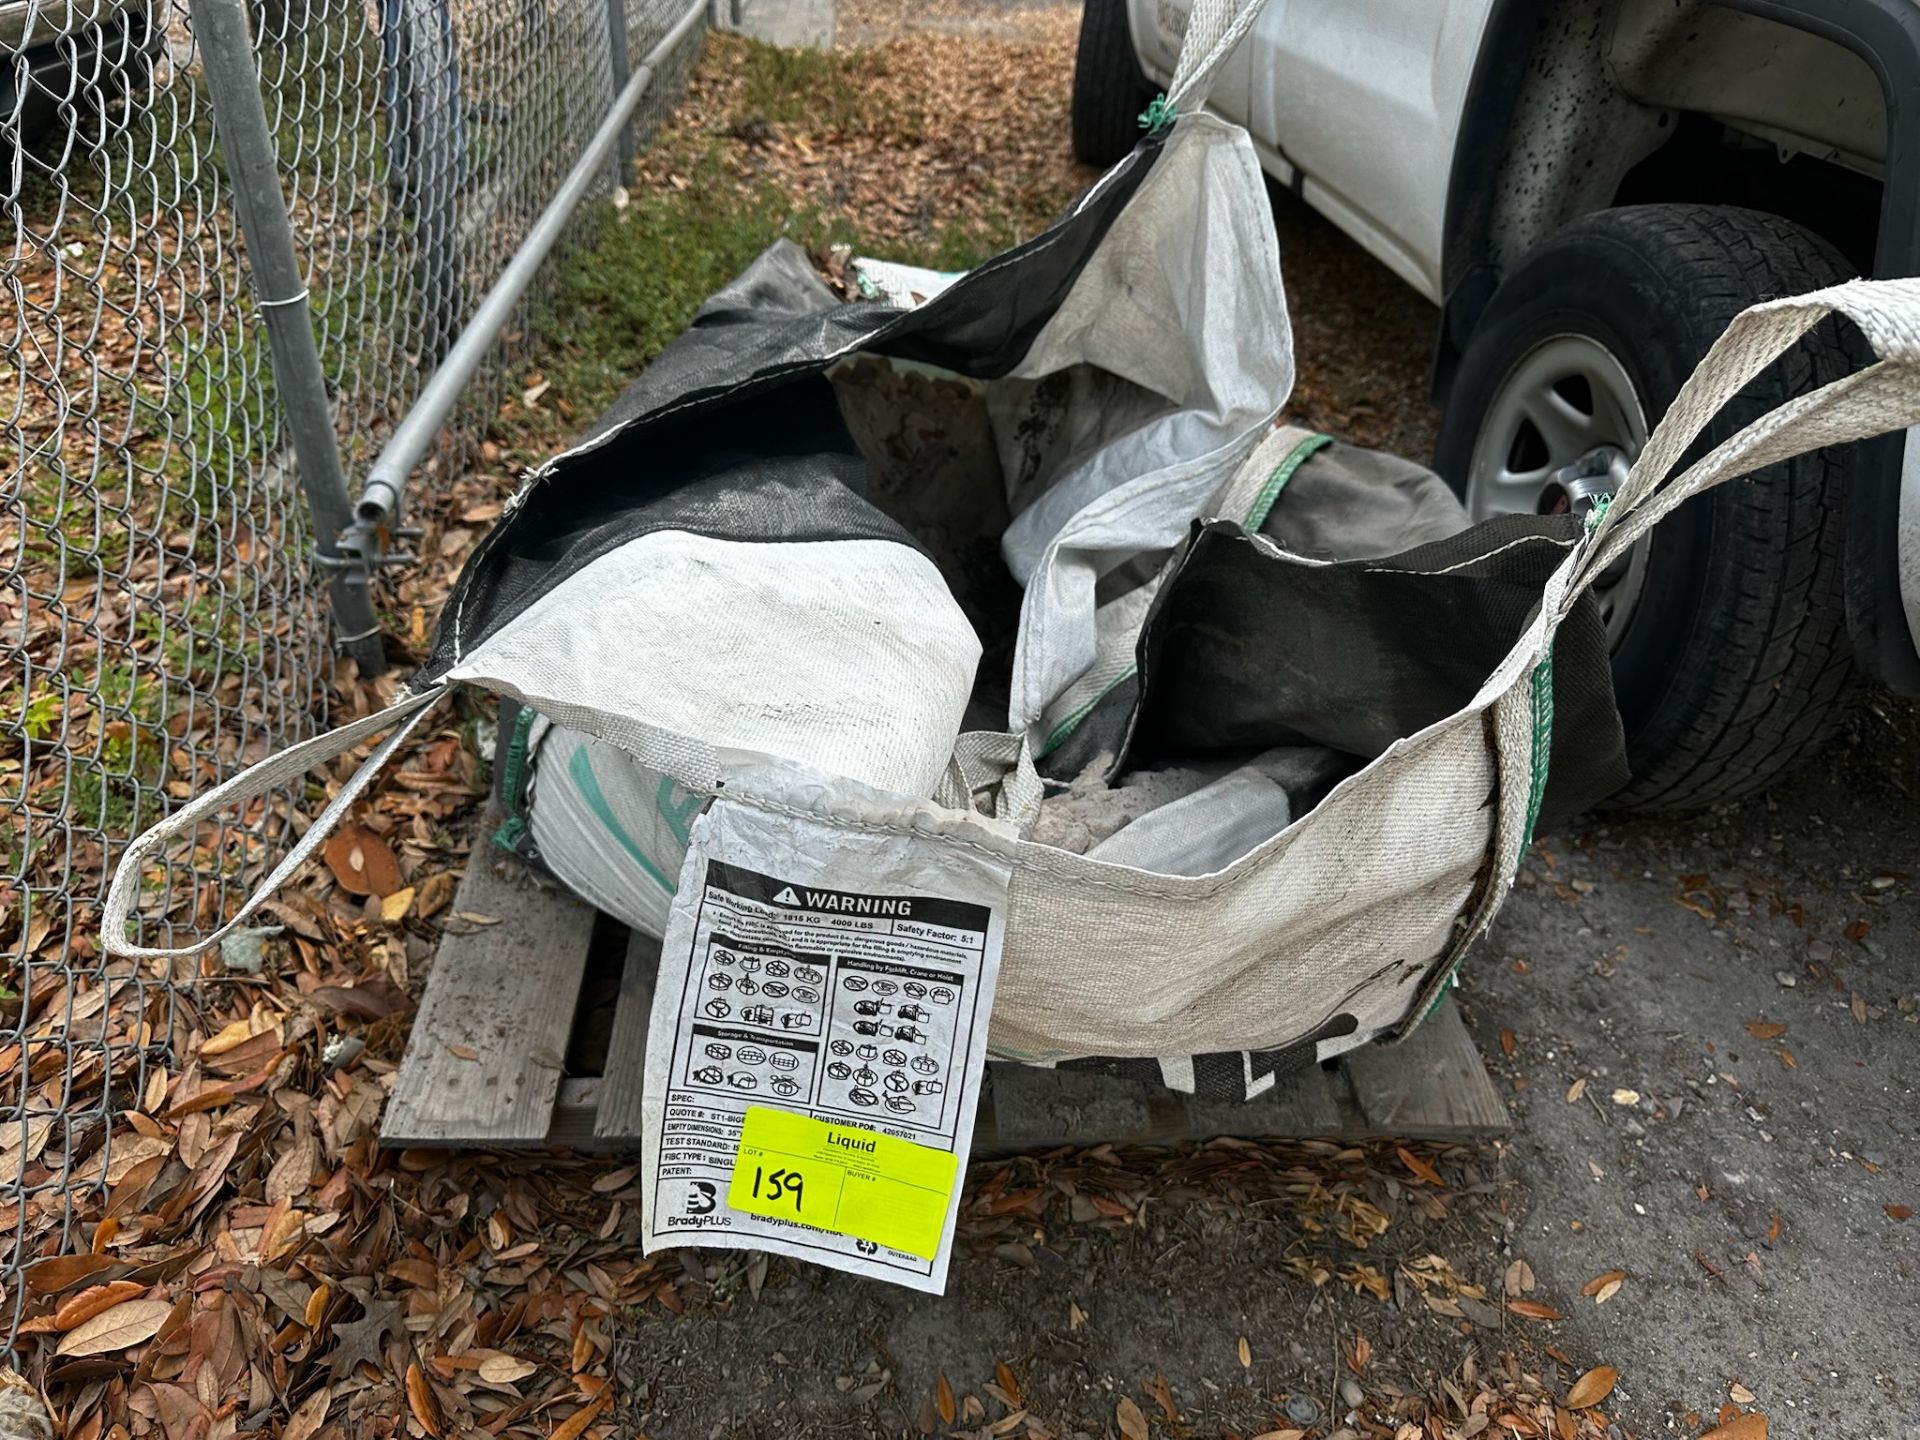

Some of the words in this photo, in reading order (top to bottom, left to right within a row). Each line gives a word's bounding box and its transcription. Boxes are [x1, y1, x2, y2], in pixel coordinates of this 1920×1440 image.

[708, 891, 724, 902] Safe
[725, 898, 753, 913] Working
[806, 916, 821, 924] KG
[830, 919, 853, 927] 4000
[854, 921, 874, 929] LBS
[806, 891, 912, 916] WARNING
[896, 924, 925, 936] Safety
[926, 929, 957, 941] Factor:
[961, 935, 974, 944] 5:1
[795, 943, 825, 951] flammable
[834, 948, 863, 956] explosive
[815, 932, 839, 940] product
[854, 936, 886, 946] dangerous
[886, 940, 905, 948] goods
[910, 943, 940, 954] hazardous
[816, 939, 851, 948] appropriate
[897, 950, 925, 959] emptying
[925, 953, 962, 964] environment
[847, 960, 875, 971] Handling
[875, 963, 884, 972] by
[909, 968, 928, 978] Crane
[937, 973, 954, 982] Hoist
[718, 1030, 742, 1040] Storage
[750, 1033, 794, 1046] Transportation
[671, 1094, 695, 1103] SPEC:
[669, 1108, 697, 1118] QUOTE
[814, 1114, 858, 1128] CUSTOMER
[667, 1123, 686, 1131] EMPTY
[687, 1123, 724, 1135] DIMENSIONS:
[686, 1138, 731, 1150] STANDARD:
[827, 1131, 877, 1153] Liquid
[665, 1152, 681, 1161] FIBC
[682, 1152, 702, 1160] TYPE
[743, 1148, 758, 1157] LOT
[662, 1167, 692, 1176] PATENT:
[847, 1170, 871, 1181] BUYER
[752, 1166, 804, 1213] 159
[668, 1216, 732, 1228] BradyPLUS
